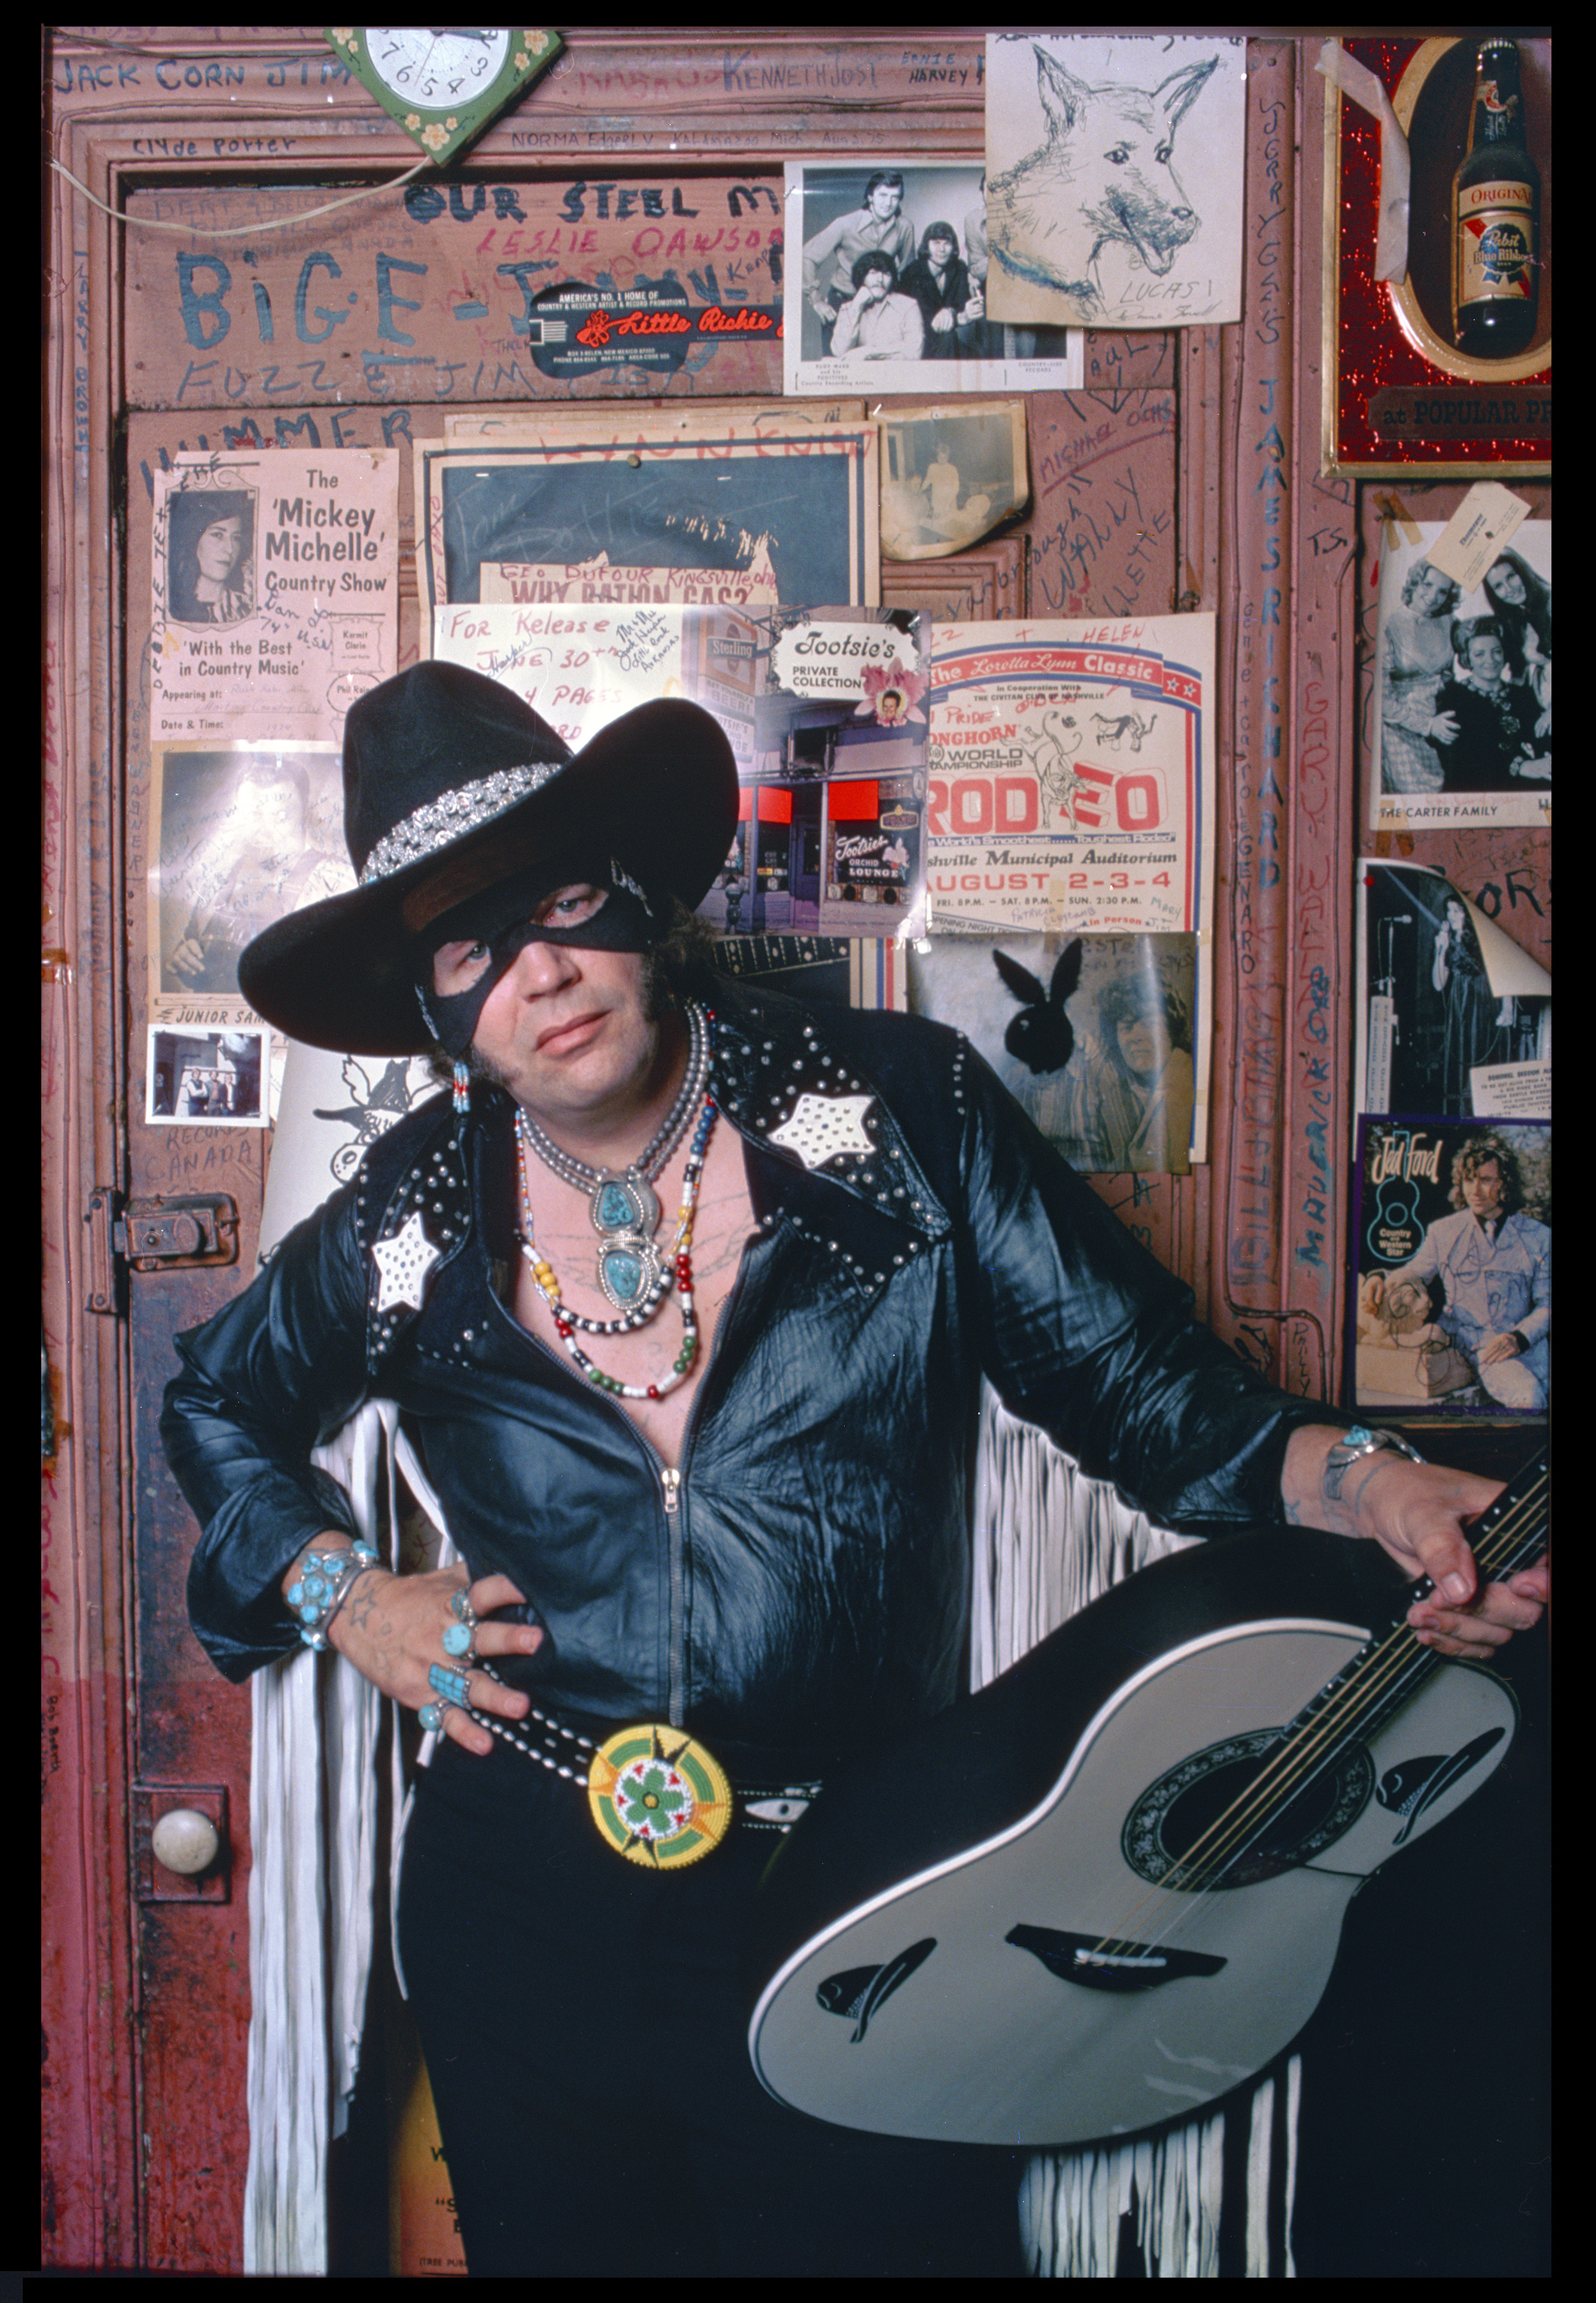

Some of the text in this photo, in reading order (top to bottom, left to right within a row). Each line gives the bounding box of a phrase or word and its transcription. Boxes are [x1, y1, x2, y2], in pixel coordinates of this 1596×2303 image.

[54, 59, 141, 93] JACK
[155, 59, 245, 91] CORN
[909, 69, 968, 84] HARVEY
[512, 132, 580, 148] NORMA
[558, 182, 700, 222] STEEL
[476, 228, 598, 257] LESLIE
[1487, 230, 1519, 246] Pabst
[1474, 251, 1496, 264] Blue
[537, 303, 563, 311] COUNTRY
[571, 302, 596, 310] WESTERN
[598, 301, 617, 309] ARTIST
[649, 298, 686, 307] PROMOTIONS
[559, 291, 658, 303] AMERICA'S NO. 1 HOME OF
[619, 306, 773, 335] Little Richie
[1384, 399, 1521, 425] at POPULAR
[1039, 423, 1116, 482] MICHAEL
[306, 469, 338, 488] The
[273, 498, 375, 537] 'Mickey
[265, 531, 385, 562] Michelle'
[265, 571, 387, 597] Country Show
[511, 580, 567, 603] WHY
[450, 606, 611, 639] FOR Release
[342, 631, 368, 639] Kermit
[1082, 621, 1146, 644] HELEN
[184, 640, 292, 656] 'With the Best
[713, 640, 753, 658] Sterling
[794, 631, 896, 658] Tootsie's
[179, 660, 304, 679] in Country Music'
[793, 666, 838, 676] PRIVATE
[971, 654, 1029, 676] Loretta
[1031, 653, 1078, 673] Lynn
[1084, 654, 1153, 680] Classic
[793, 677, 862, 689] COLLECTION
[162, 690, 223, 701] Appearing at:
[161, 719, 224, 729] Date & Time:
[929, 724, 1017, 747] ONGHORN
[948, 747, 1023, 761] WORLD
[1380, 805, 1497, 818] THE CARTER FAMILY
[986, 849, 1177, 867] Municipal Auditorium
[849, 867, 898, 878] LOUNGE
[937, 898, 955, 906] FRI.
[965, 898, 984, 906] P.M.
[1001, 897, 1022, 905] SAT.
[1069, 896, 1089, 905] SUN.
[1096, 896, 1119, 905] 2:30
[1121, 896, 1142, 905] P.M.
[968, 921, 996, 933] NIGHT
[1104, 916, 1142, 925] Person
[176, 1011, 228, 1024] JUNIOR
[1379, 1228, 1412, 1239] Country
[1379, 1240, 1412, 1250] Western
[1386, 1247, 1404, 1257] Star
